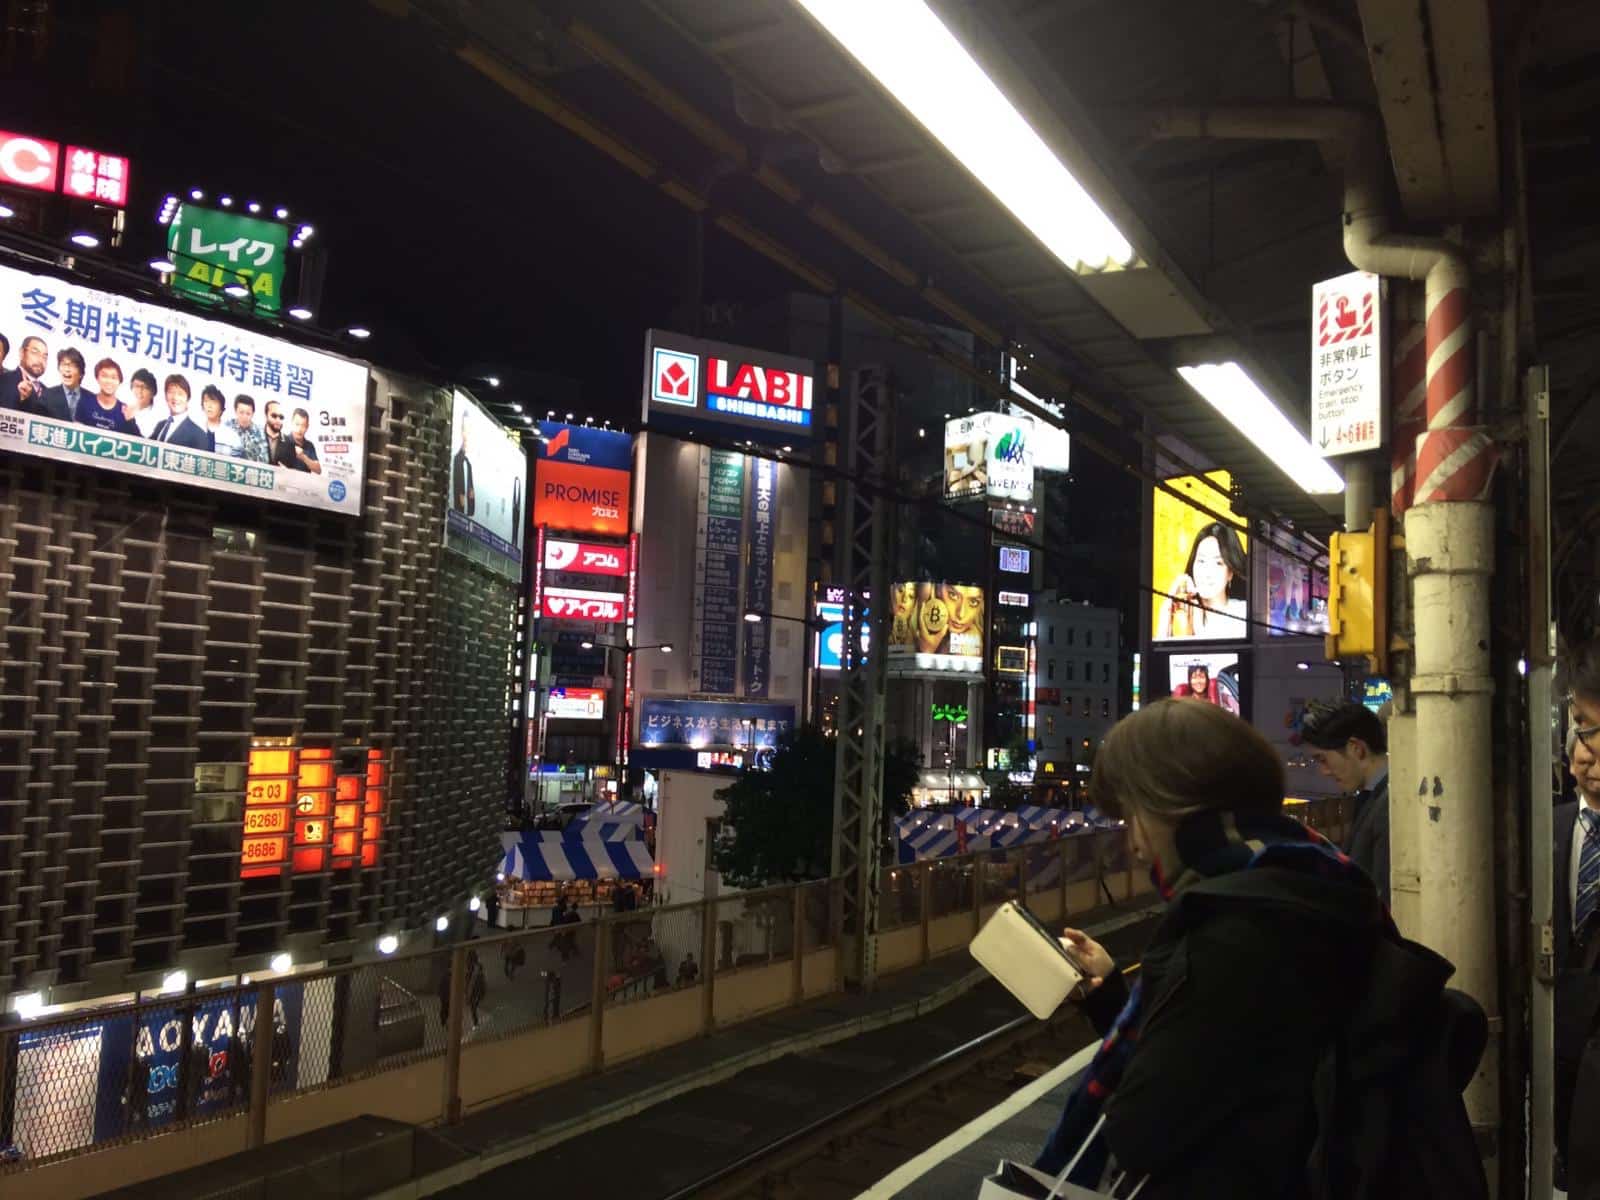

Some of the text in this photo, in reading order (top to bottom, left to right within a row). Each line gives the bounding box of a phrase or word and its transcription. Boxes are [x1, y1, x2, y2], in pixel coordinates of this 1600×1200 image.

[191, 228, 275, 266] レイク
[21, 287, 313, 400] 冬期特別招待講習
[1320, 344, 1373, 367] 非常停止
[707, 357, 813, 410] LABI
[1319, 368, 1360, 386] ボタン
[30, 423, 157, 467] 東進ハイスクール
[545, 482, 621, 507] PROMISE
[592, 506, 619, 519] プロミス
[582, 551, 620, 568] アコム
[565, 599, 618, 618] アイフル
[267, 783, 282, 800] 03
[246, 811, 283, 831] (6268)
